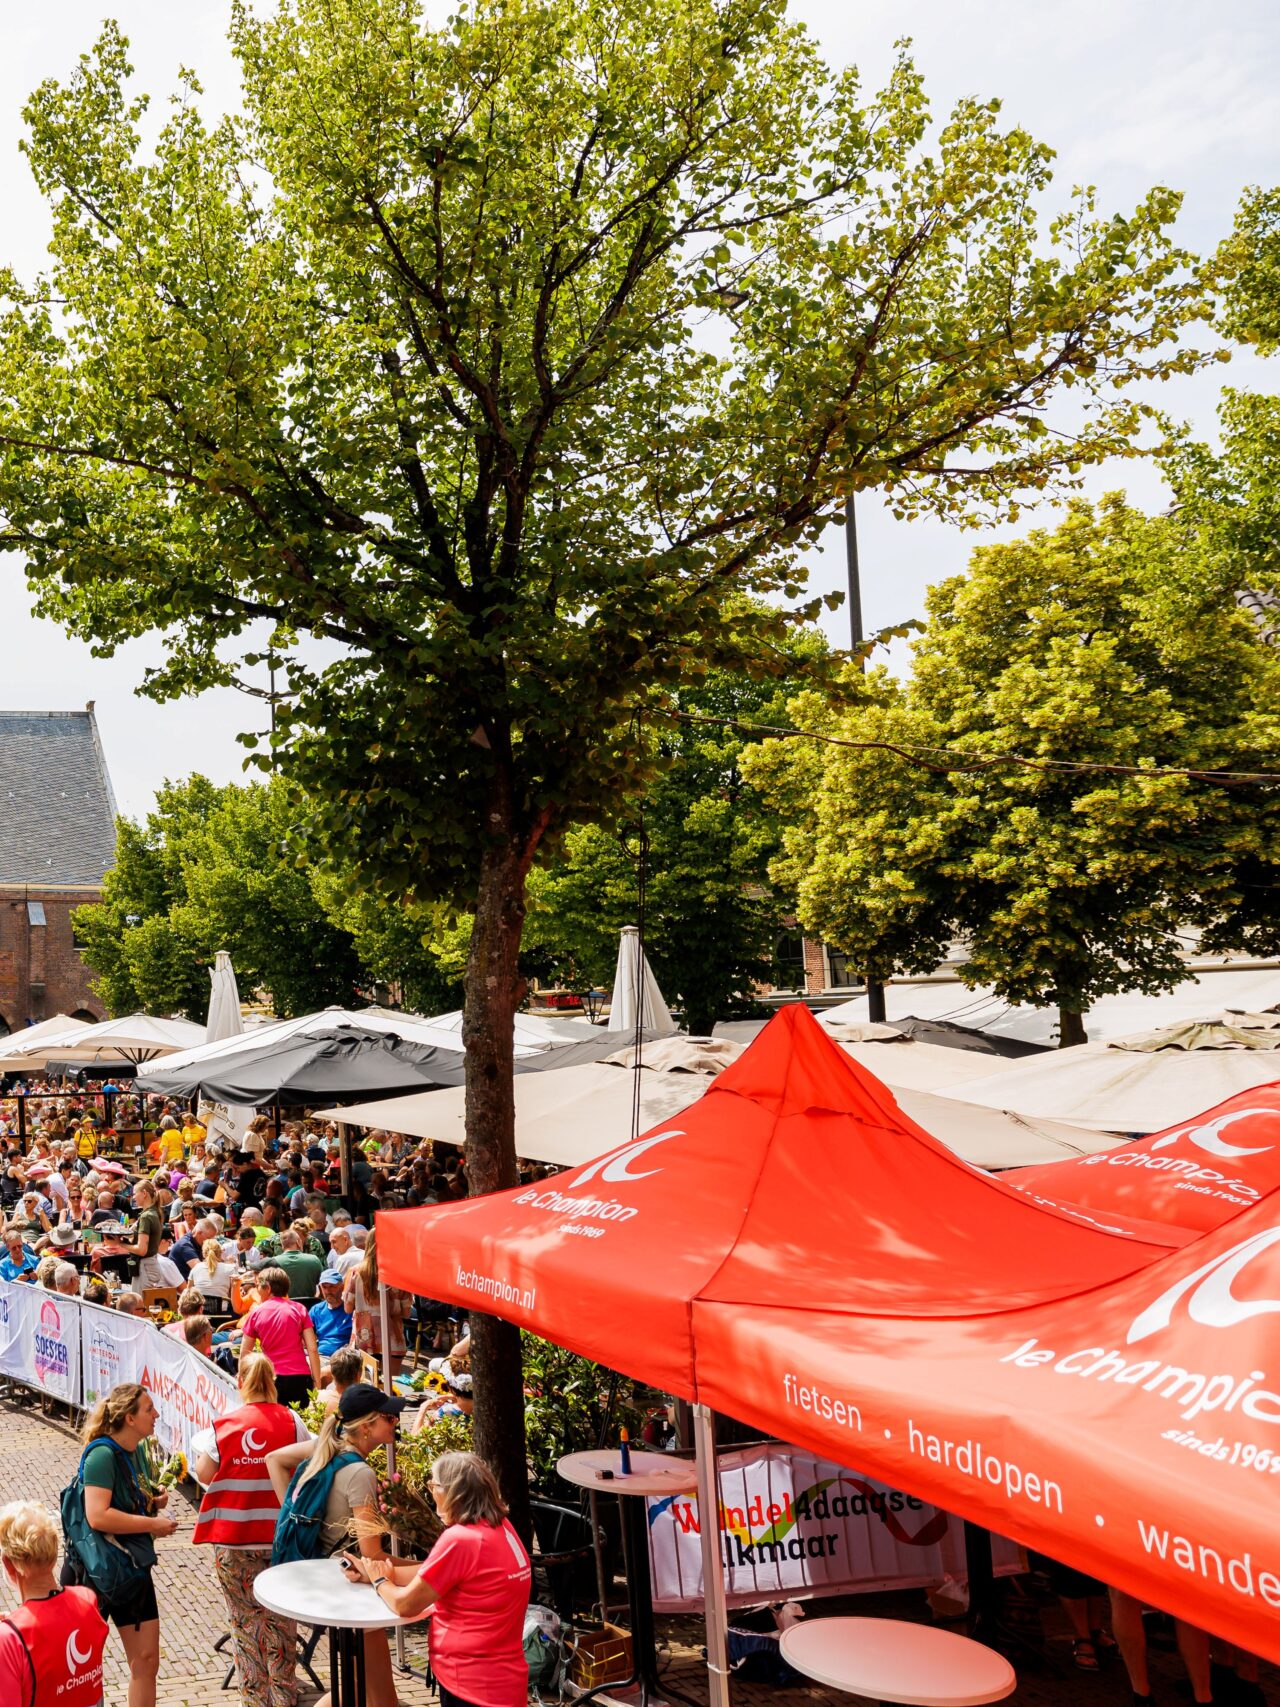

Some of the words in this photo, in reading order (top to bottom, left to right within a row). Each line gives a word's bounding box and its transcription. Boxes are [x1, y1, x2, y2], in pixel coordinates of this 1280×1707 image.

[1077, 1153, 1103, 1166] le
[1107, 1152, 1262, 1200] Champio
[1174, 1181, 1218, 1198] sinds
[1214, 1192, 1254, 1207] 1969
[512, 1188, 535, 1204] le
[531, 1191, 639, 1222] Champion
[580, 1225, 606, 1239] 1969
[456, 1265, 536, 1311] lechampion.nl
[35, 1334, 68, 1364] SOESTER
[999, 1338, 1056, 1367] le
[1054, 1347, 1280, 1424] Champio
[233, 1457, 241, 1465] le
[241, 1456, 266, 1465] Cham
[1160, 1429, 1229, 1461] sinds
[1228, 1441, 1280, 1474] 1969
[783, 1373, 862, 1431] fietsen
[908, 1419, 1063, 1513] hardlopen
[1138, 1518, 1280, 1608] wande
[672, 1488, 923, 1535] Wndel4daagse
[723, 1531, 838, 1569] lkmaar
[56, 1684, 65, 1695] le
